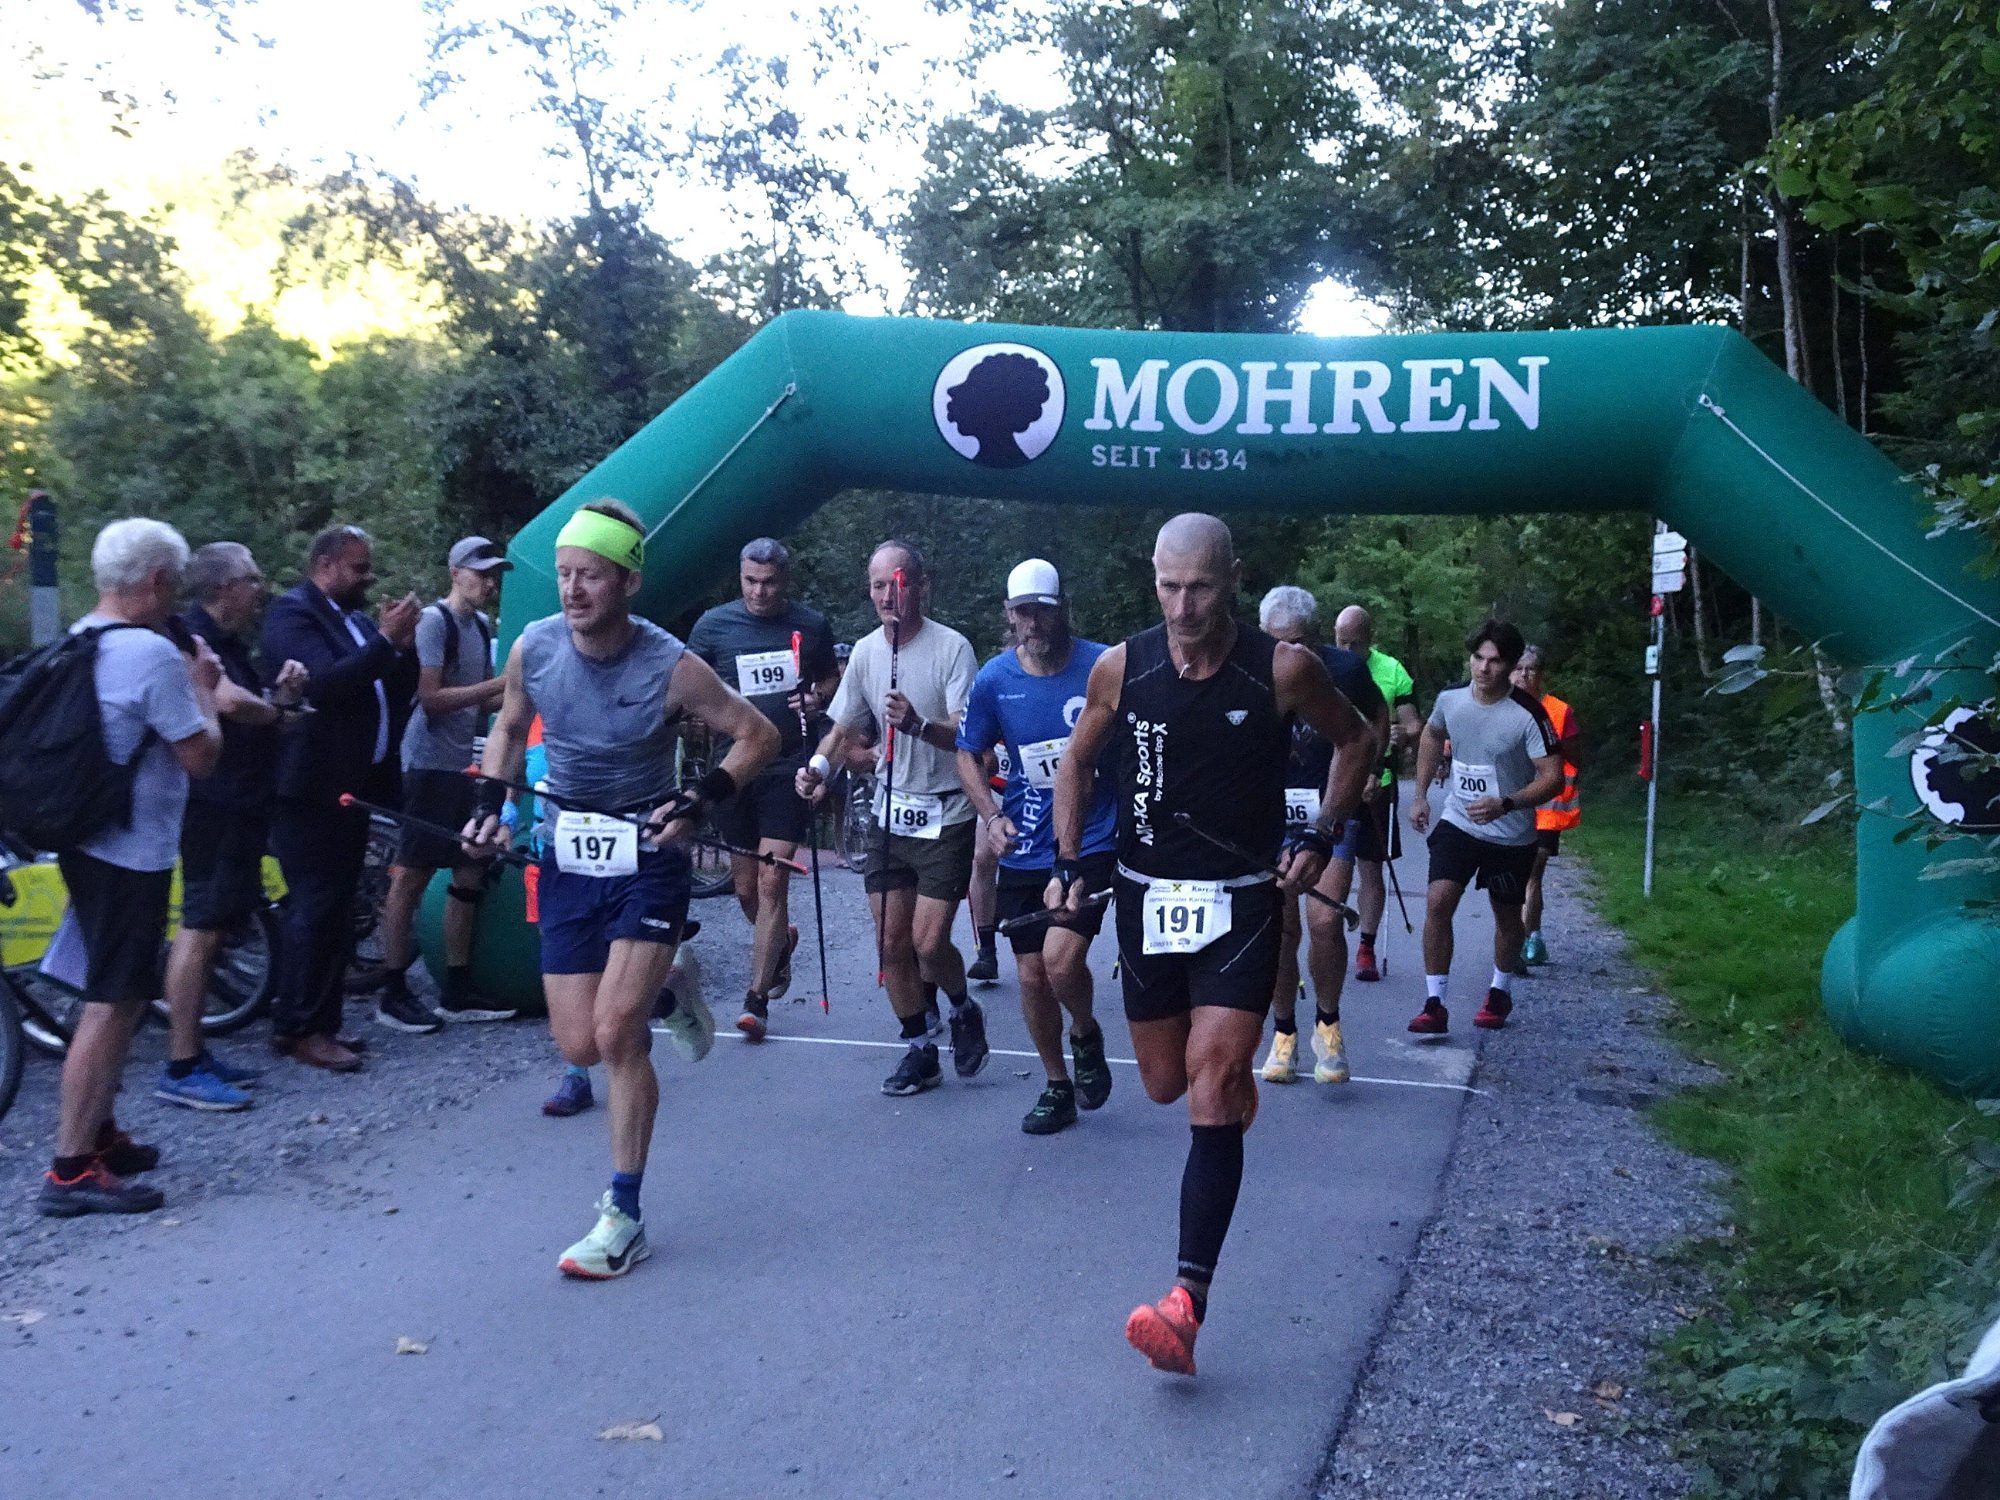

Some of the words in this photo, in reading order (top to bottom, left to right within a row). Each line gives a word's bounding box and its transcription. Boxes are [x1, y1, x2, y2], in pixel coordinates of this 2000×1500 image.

[1083, 355, 1550, 435] MOHREN
[1091, 444, 1161, 468] SEIT
[1180, 447, 1248, 471] 1834
[751, 666, 784, 684] 199
[1460, 776, 1487, 792] 200
[894, 806, 928, 827] 198
[571, 835, 617, 861] 197
[1156, 905, 1205, 934] 191
